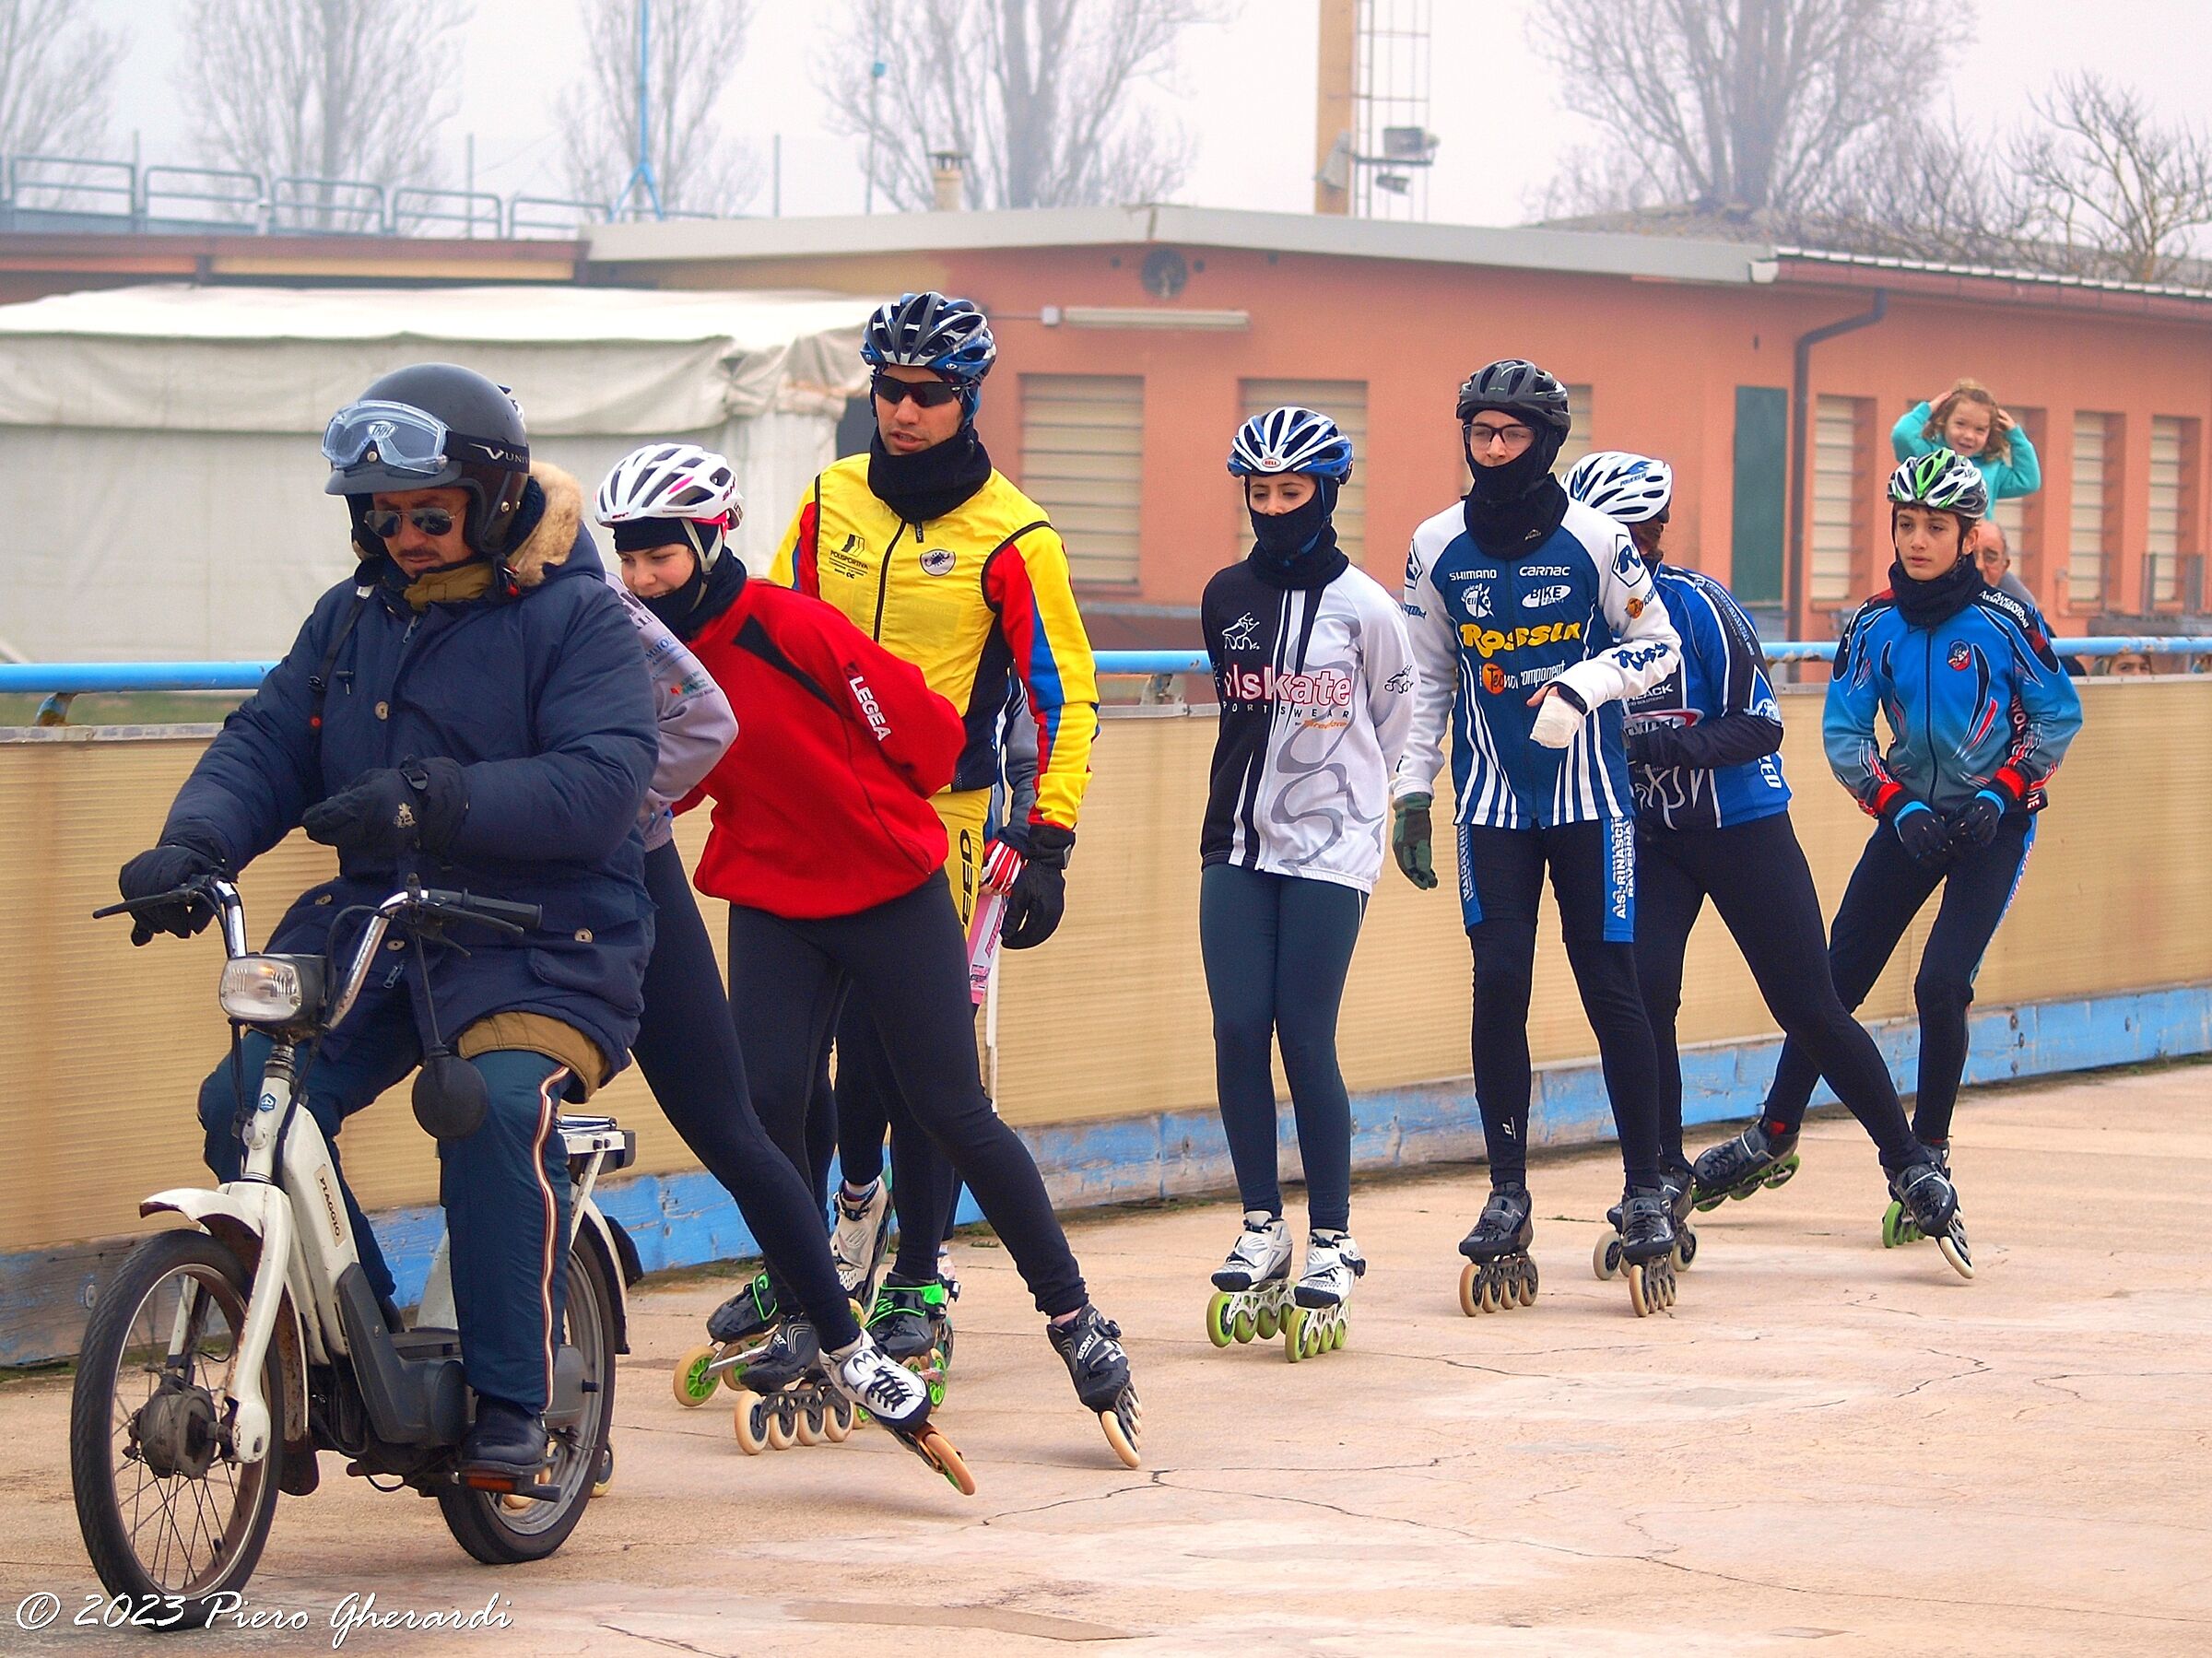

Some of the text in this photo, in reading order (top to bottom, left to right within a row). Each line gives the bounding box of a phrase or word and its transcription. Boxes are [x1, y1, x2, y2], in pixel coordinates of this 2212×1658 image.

[1449, 569, 1498, 582] SHIMANO
[1530, 586, 1562, 601] BIKE
[849, 676, 891, 741] LEGEA
[319, 1177, 340, 1237] PIAGGIO
[1077, 1335, 1094, 1360] BONT
